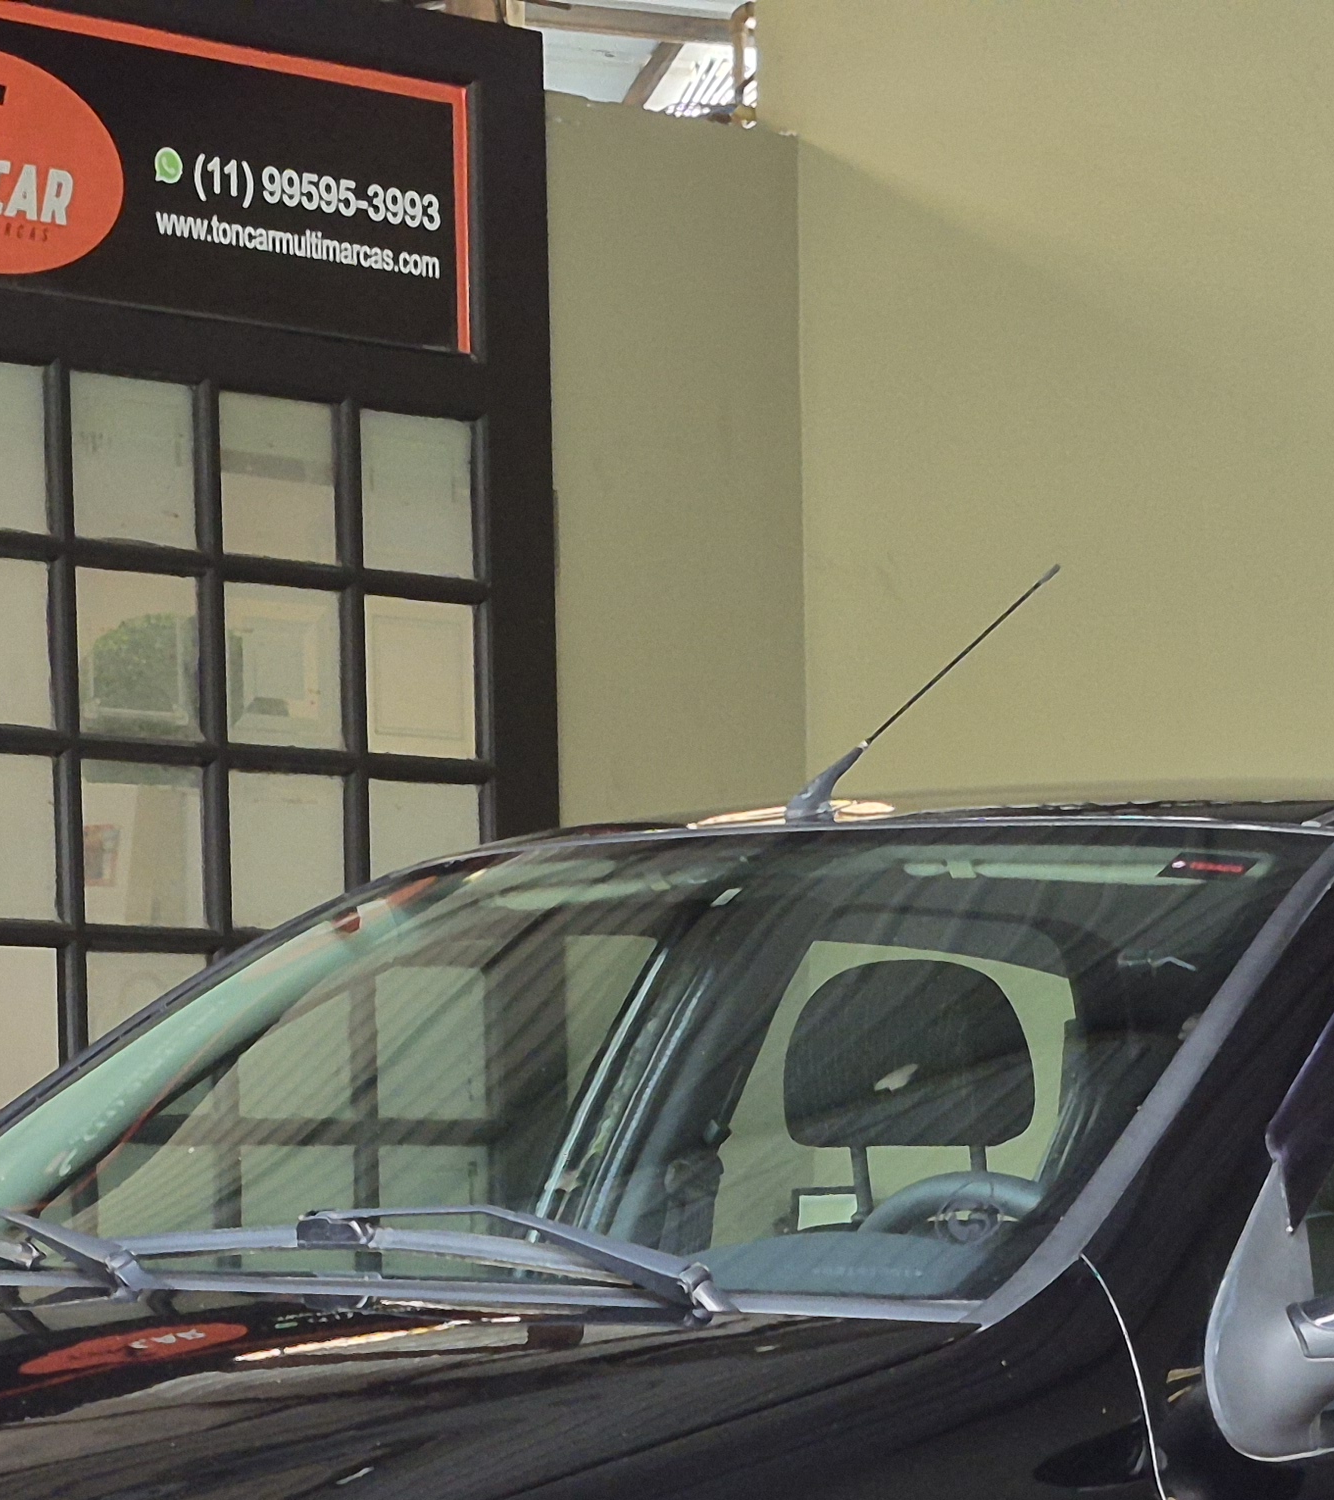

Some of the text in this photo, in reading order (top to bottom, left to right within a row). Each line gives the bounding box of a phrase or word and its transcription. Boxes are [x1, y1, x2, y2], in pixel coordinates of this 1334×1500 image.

[193, 152, 441, 231] (11) 99595-3993
[155, 210, 441, 280] www.toncarmultimarcas.com
